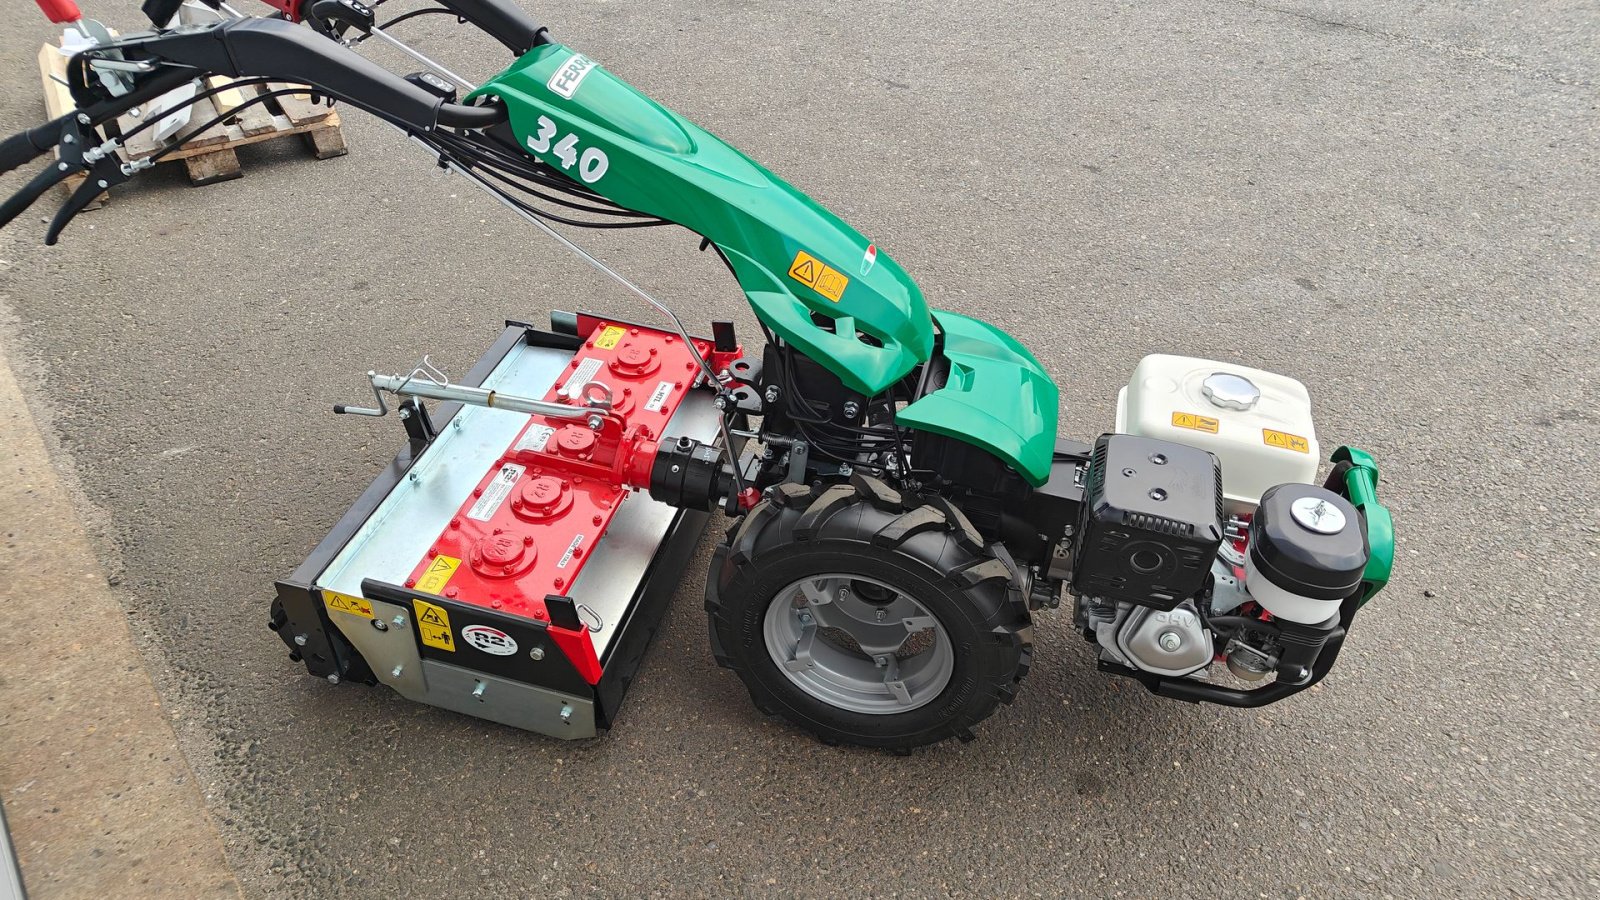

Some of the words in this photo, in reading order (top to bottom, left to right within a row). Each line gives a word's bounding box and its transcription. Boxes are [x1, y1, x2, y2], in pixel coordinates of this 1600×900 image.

[526, 115, 609, 184] 340
[1155, 611, 1196, 628] OHV
[474, 632, 506, 647] R2
